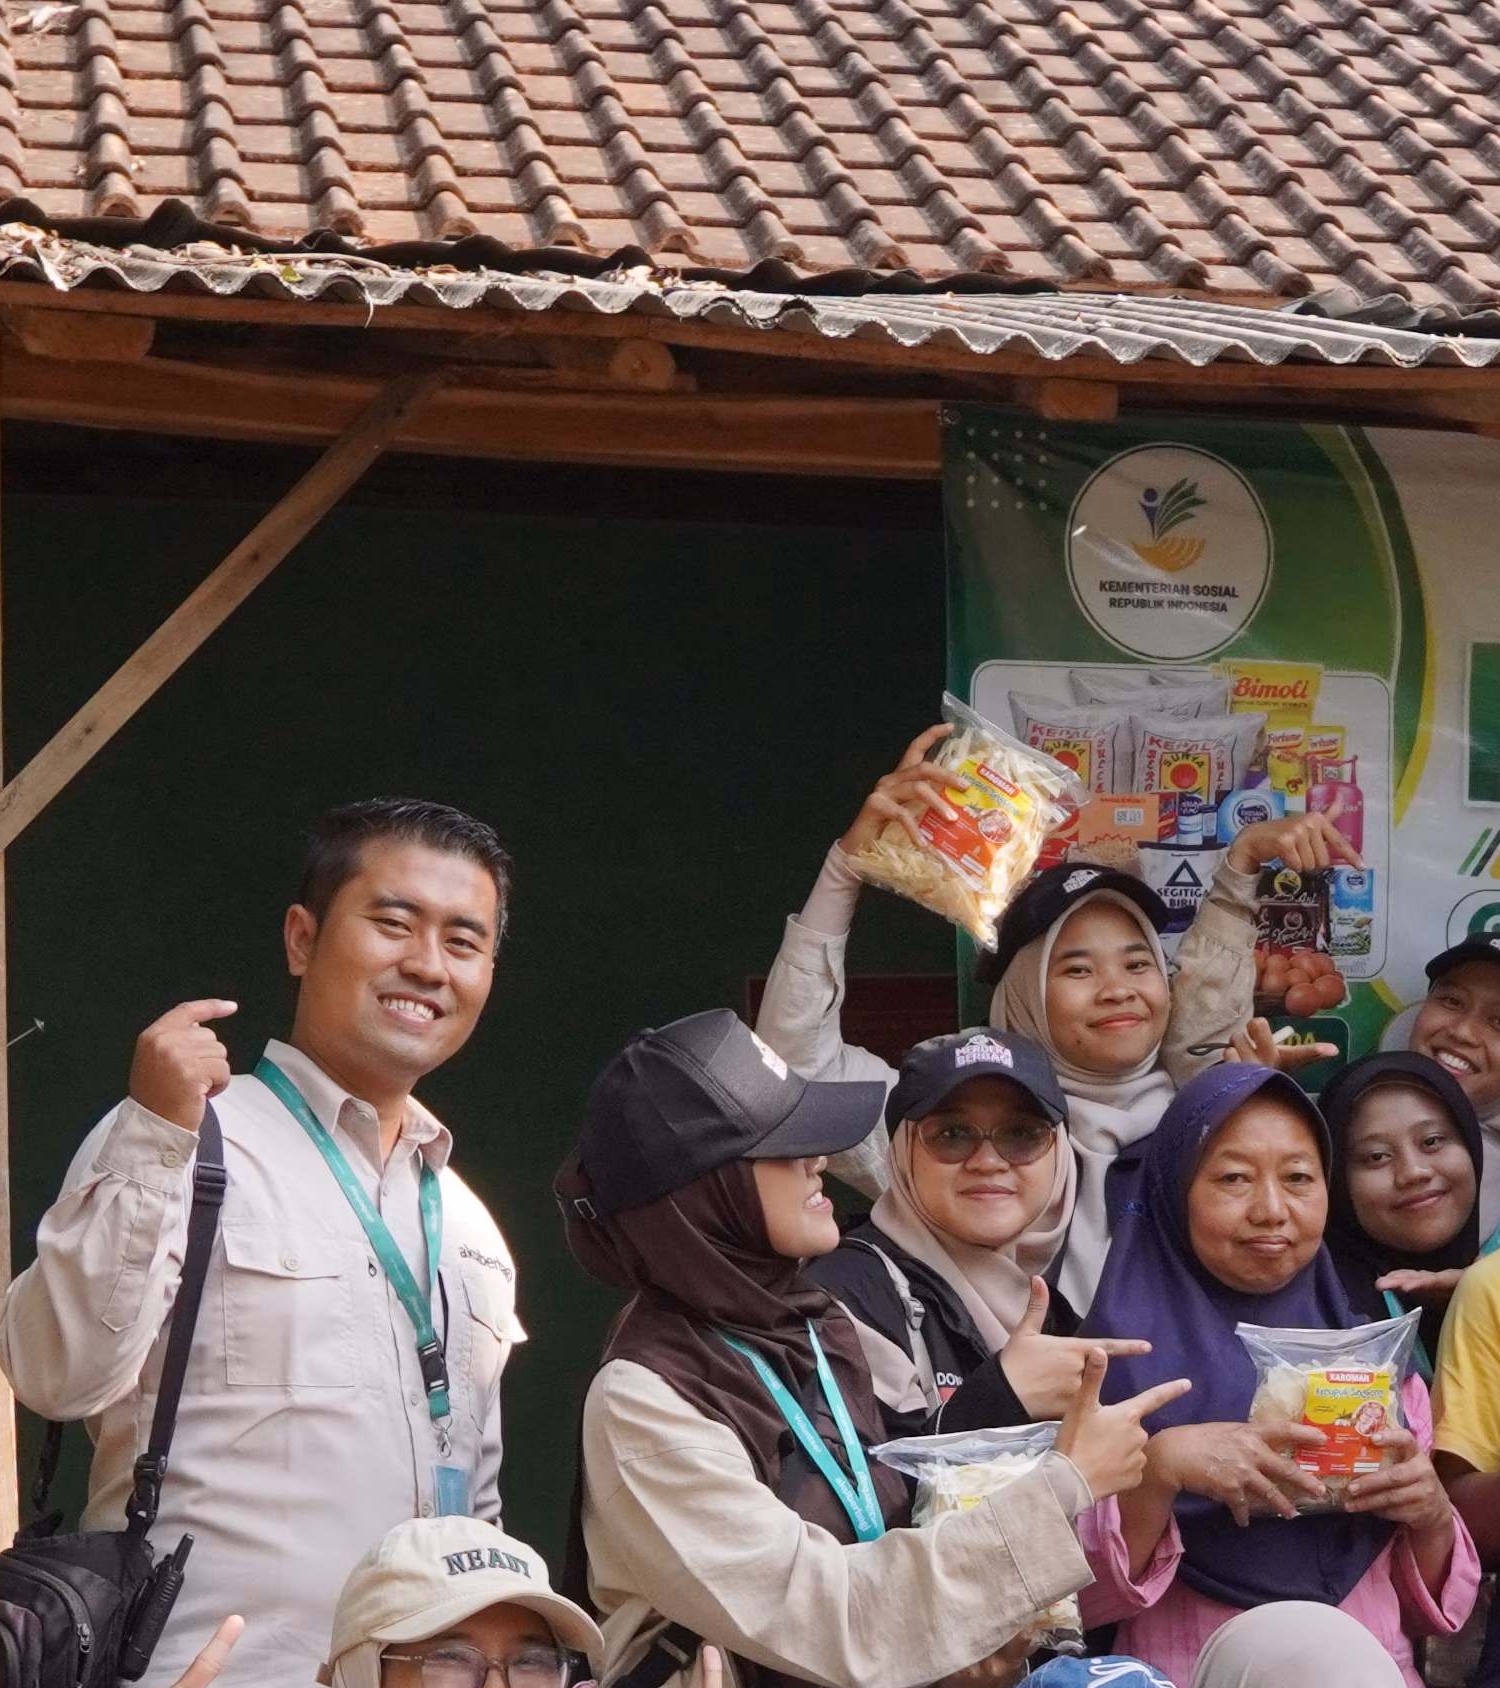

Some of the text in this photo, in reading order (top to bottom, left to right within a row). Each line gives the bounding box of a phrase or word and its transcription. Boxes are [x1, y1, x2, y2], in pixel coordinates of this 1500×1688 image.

[1100, 580, 1239, 598] KEMENTERIAN SOSIAL
[1109, 598, 1227, 612] REPUBLIK INDONESIA
[979, 766, 1016, 795] KAROMAH
[955, 1044, 1012, 1058] MERDEKA
[956, 1053, 1014, 1068] BERBAGI
[1329, 1373, 1370, 1383] KAROMAH
[794, 1411, 821, 1453] Volunteer
[835, 1476, 871, 1532] aksiberbagi
